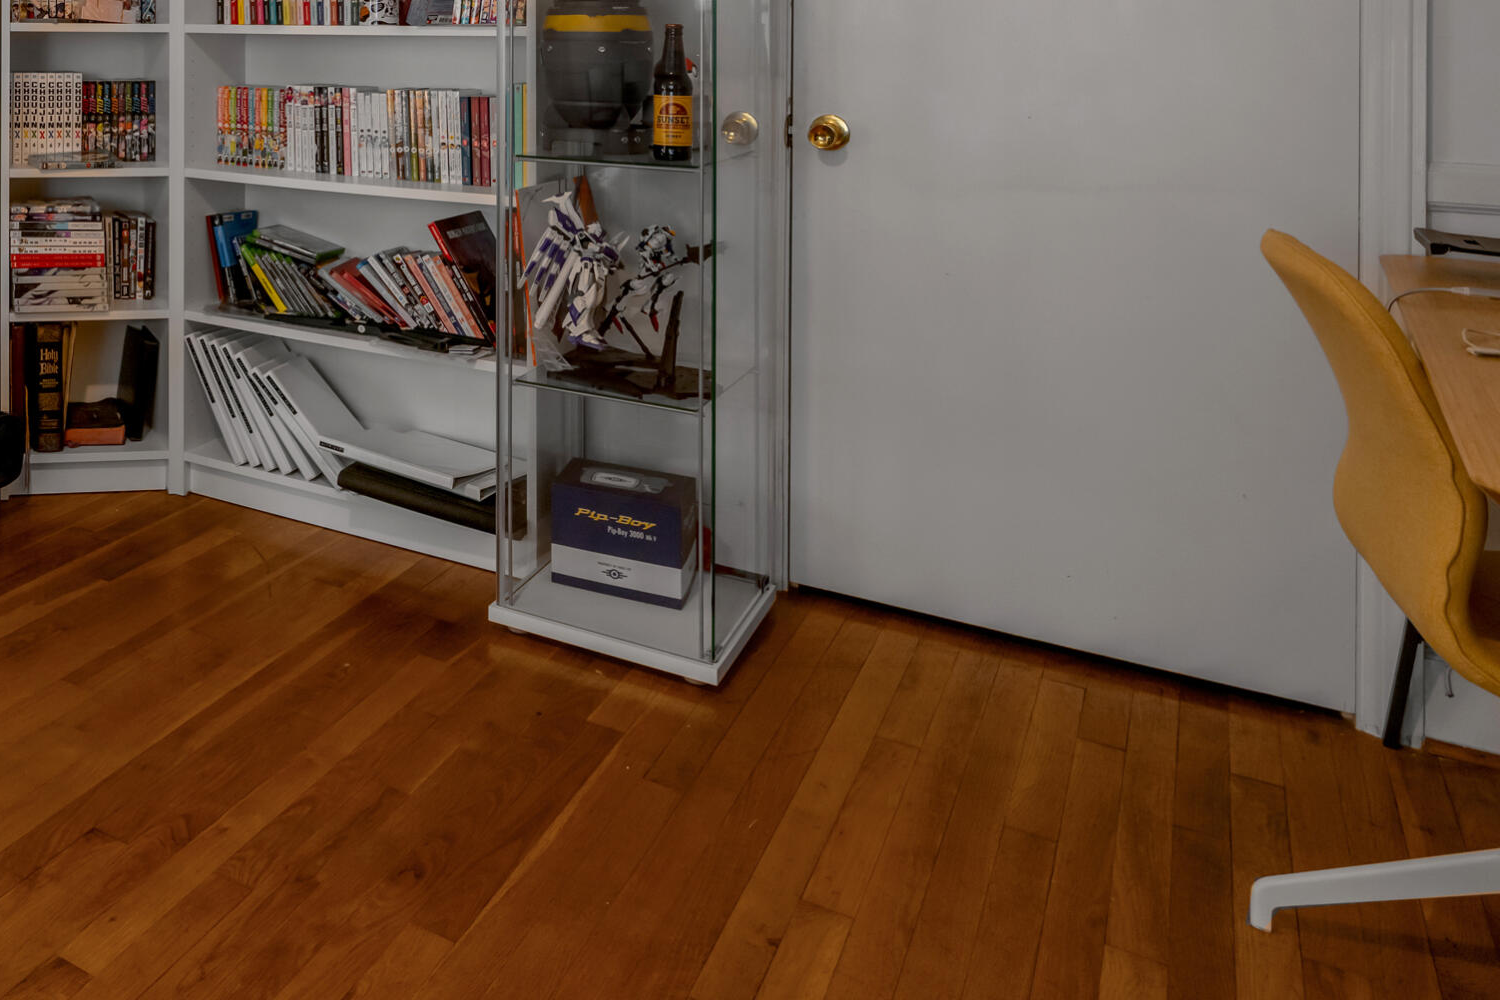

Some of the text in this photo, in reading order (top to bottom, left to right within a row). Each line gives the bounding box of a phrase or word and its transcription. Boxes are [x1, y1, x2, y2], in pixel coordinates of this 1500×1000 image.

[657, 116, 689, 124] SUNSET
[24, 130, 28, 138] X
[40, 131, 45, 139] X
[66, 130, 70, 138] X
[40, 348, 58, 363] Holy
[39, 362, 58, 375] Bible
[574, 507, 657, 530] Pip-Boy
[629, 530, 644, 540] 3000
